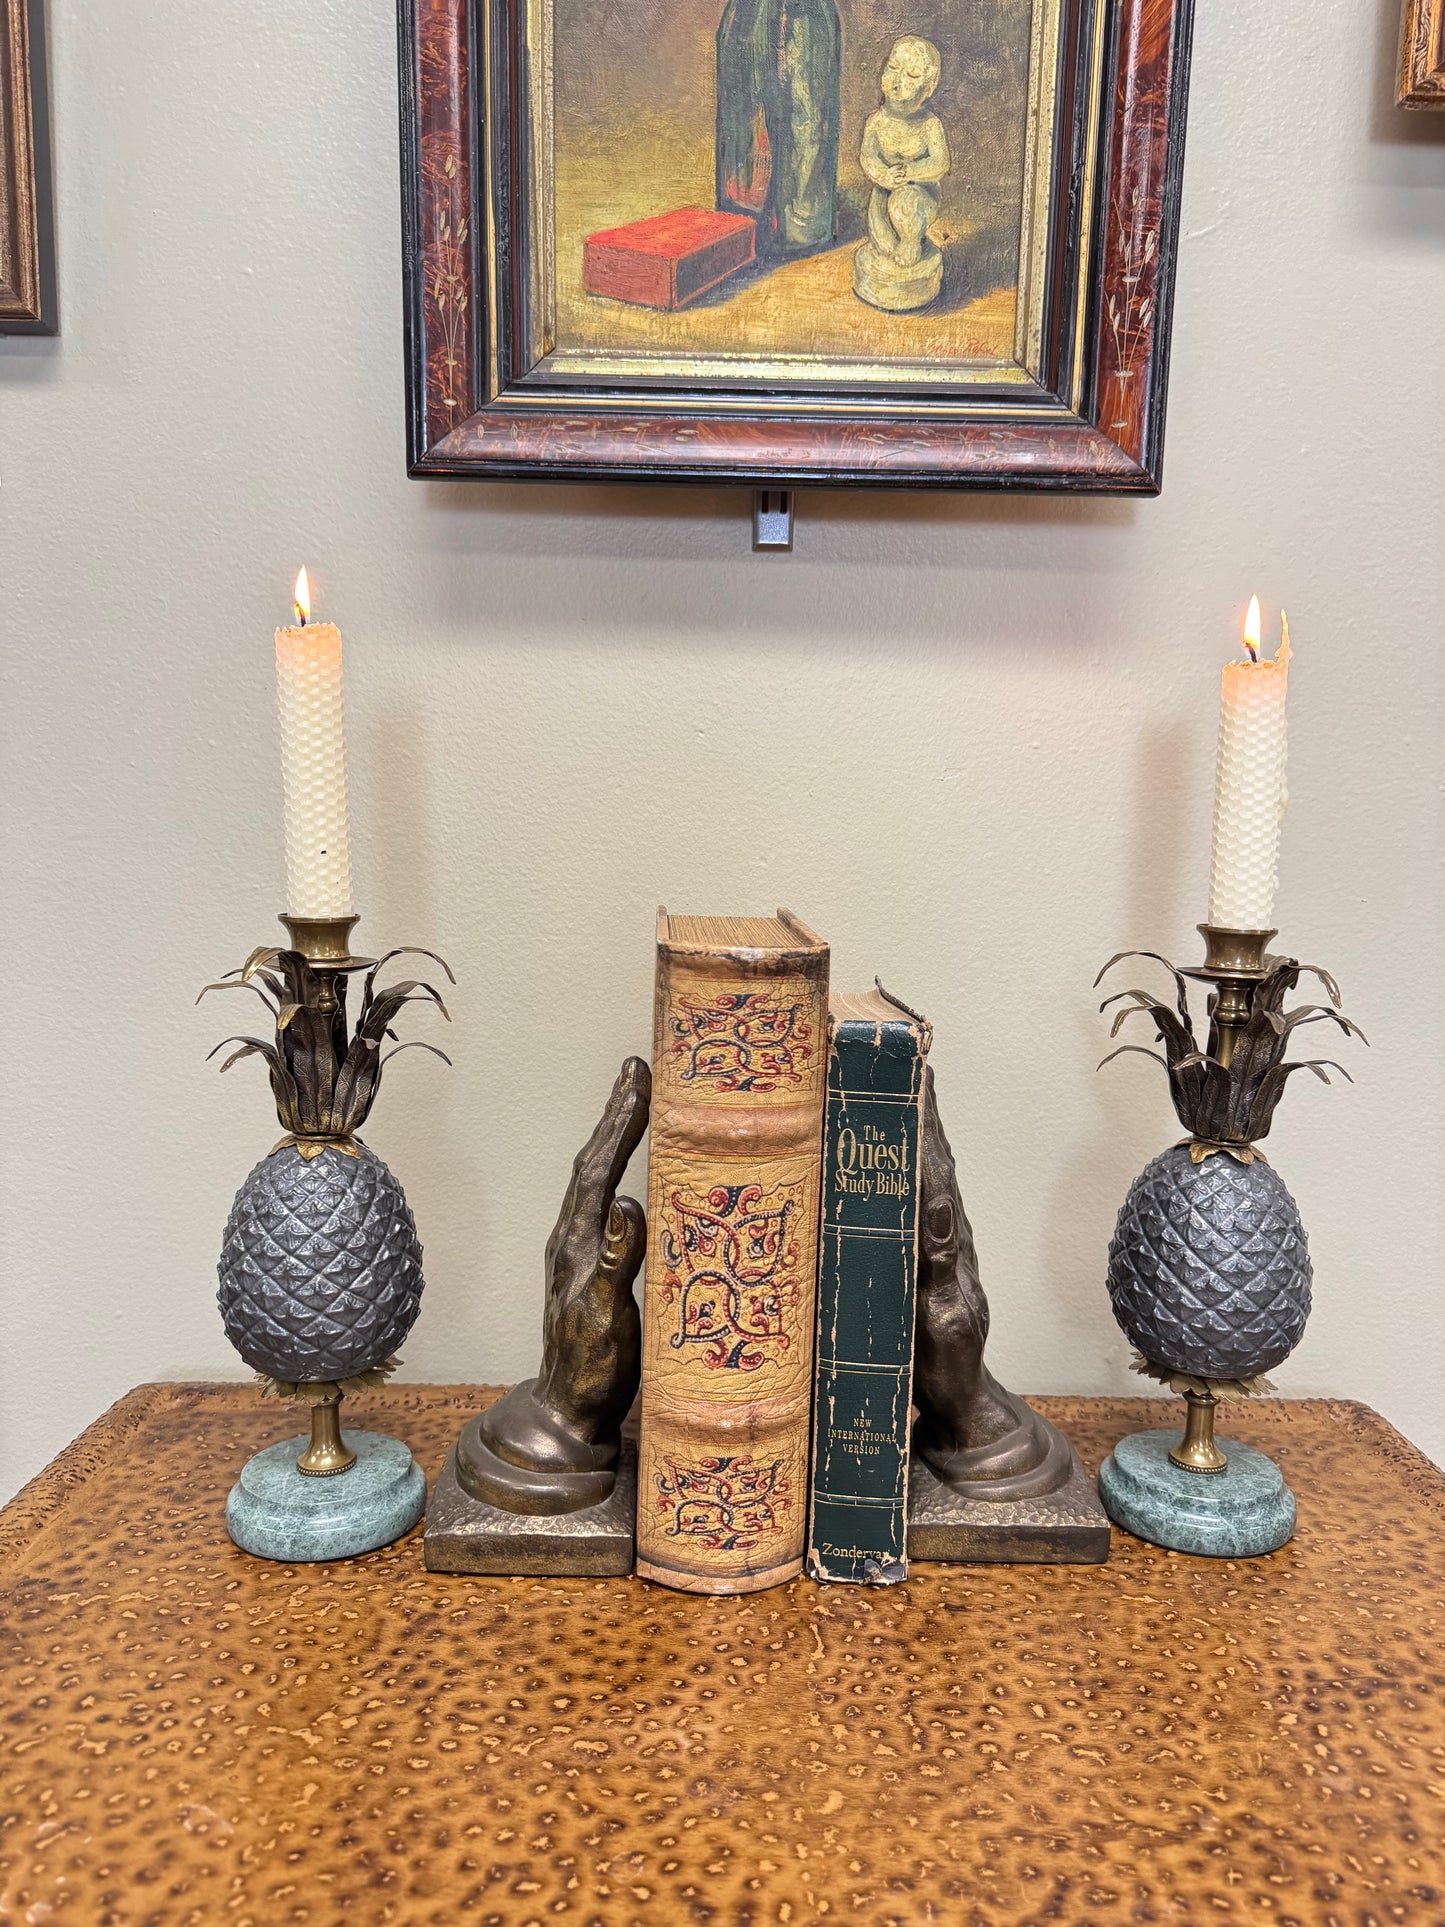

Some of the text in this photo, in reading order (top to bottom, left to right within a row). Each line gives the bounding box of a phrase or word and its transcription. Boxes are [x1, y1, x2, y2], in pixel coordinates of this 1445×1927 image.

[863, 1124, 886, 1141] The
[836, 1127, 910, 1175] Quest
[834, 1169, 910, 1202] Study Bible
[853, 1417, 873, 1428] NEW
[827, 1428, 897, 1444] INTERNATIONAL
[842, 1443, 880, 1455] VERSION
